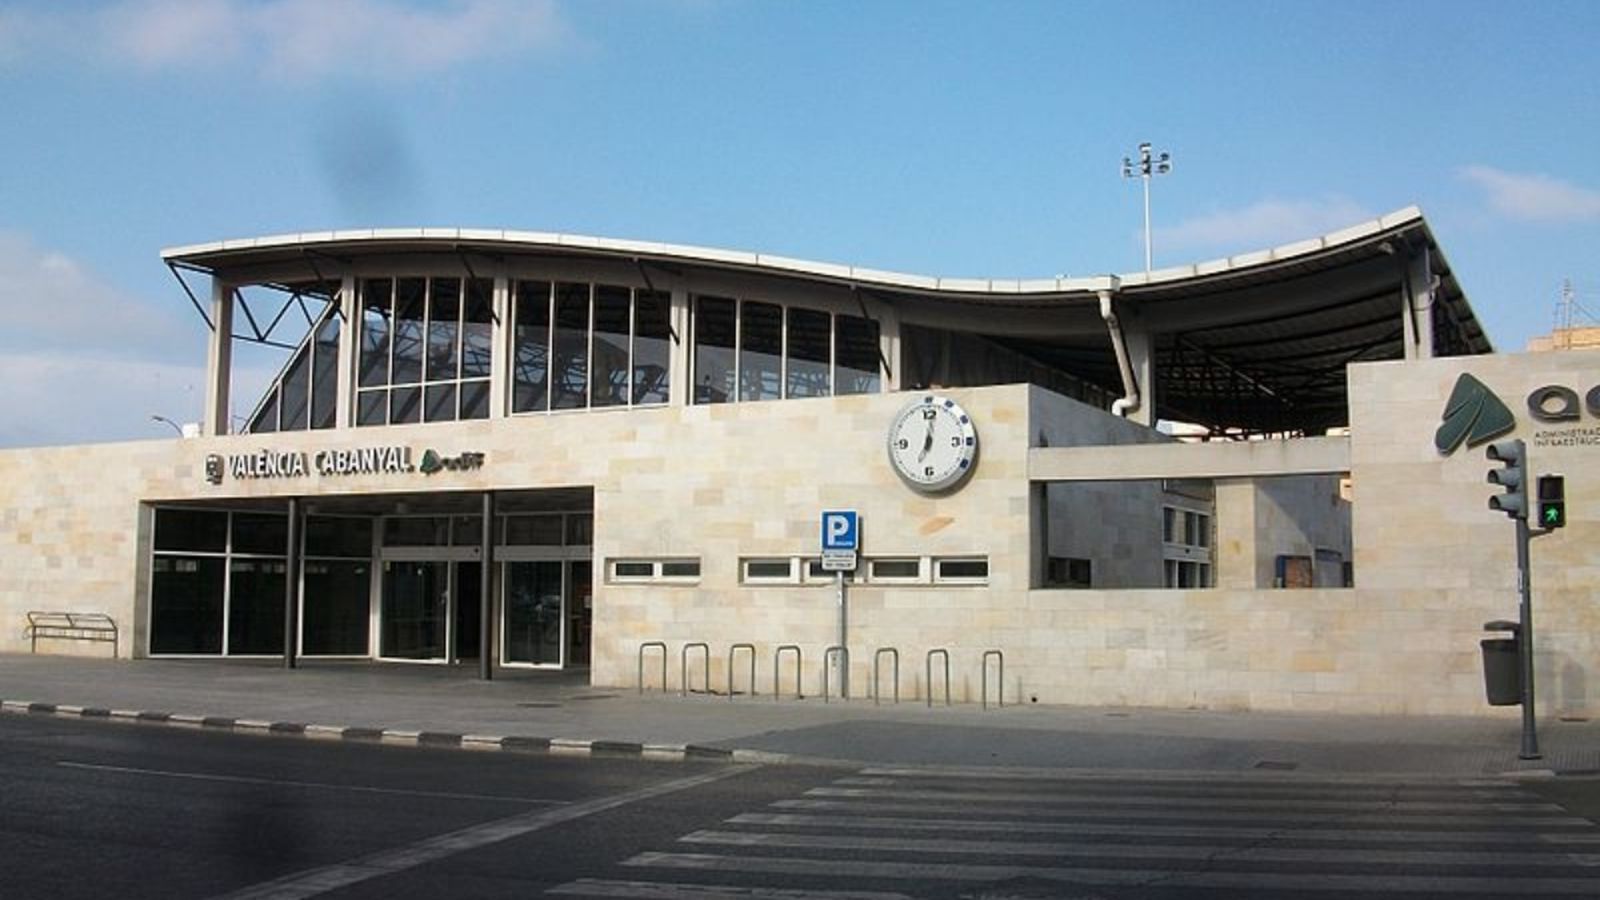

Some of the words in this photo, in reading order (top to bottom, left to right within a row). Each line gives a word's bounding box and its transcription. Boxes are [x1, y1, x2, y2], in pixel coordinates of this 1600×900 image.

[923, 409, 937, 420] 12
[899, 439, 908, 450] 9
[951, 436, 960, 448] 3
[314, 445, 413, 475] CABANYAL
[924, 466, 934, 477] 6
[827, 515, 849, 546] P
